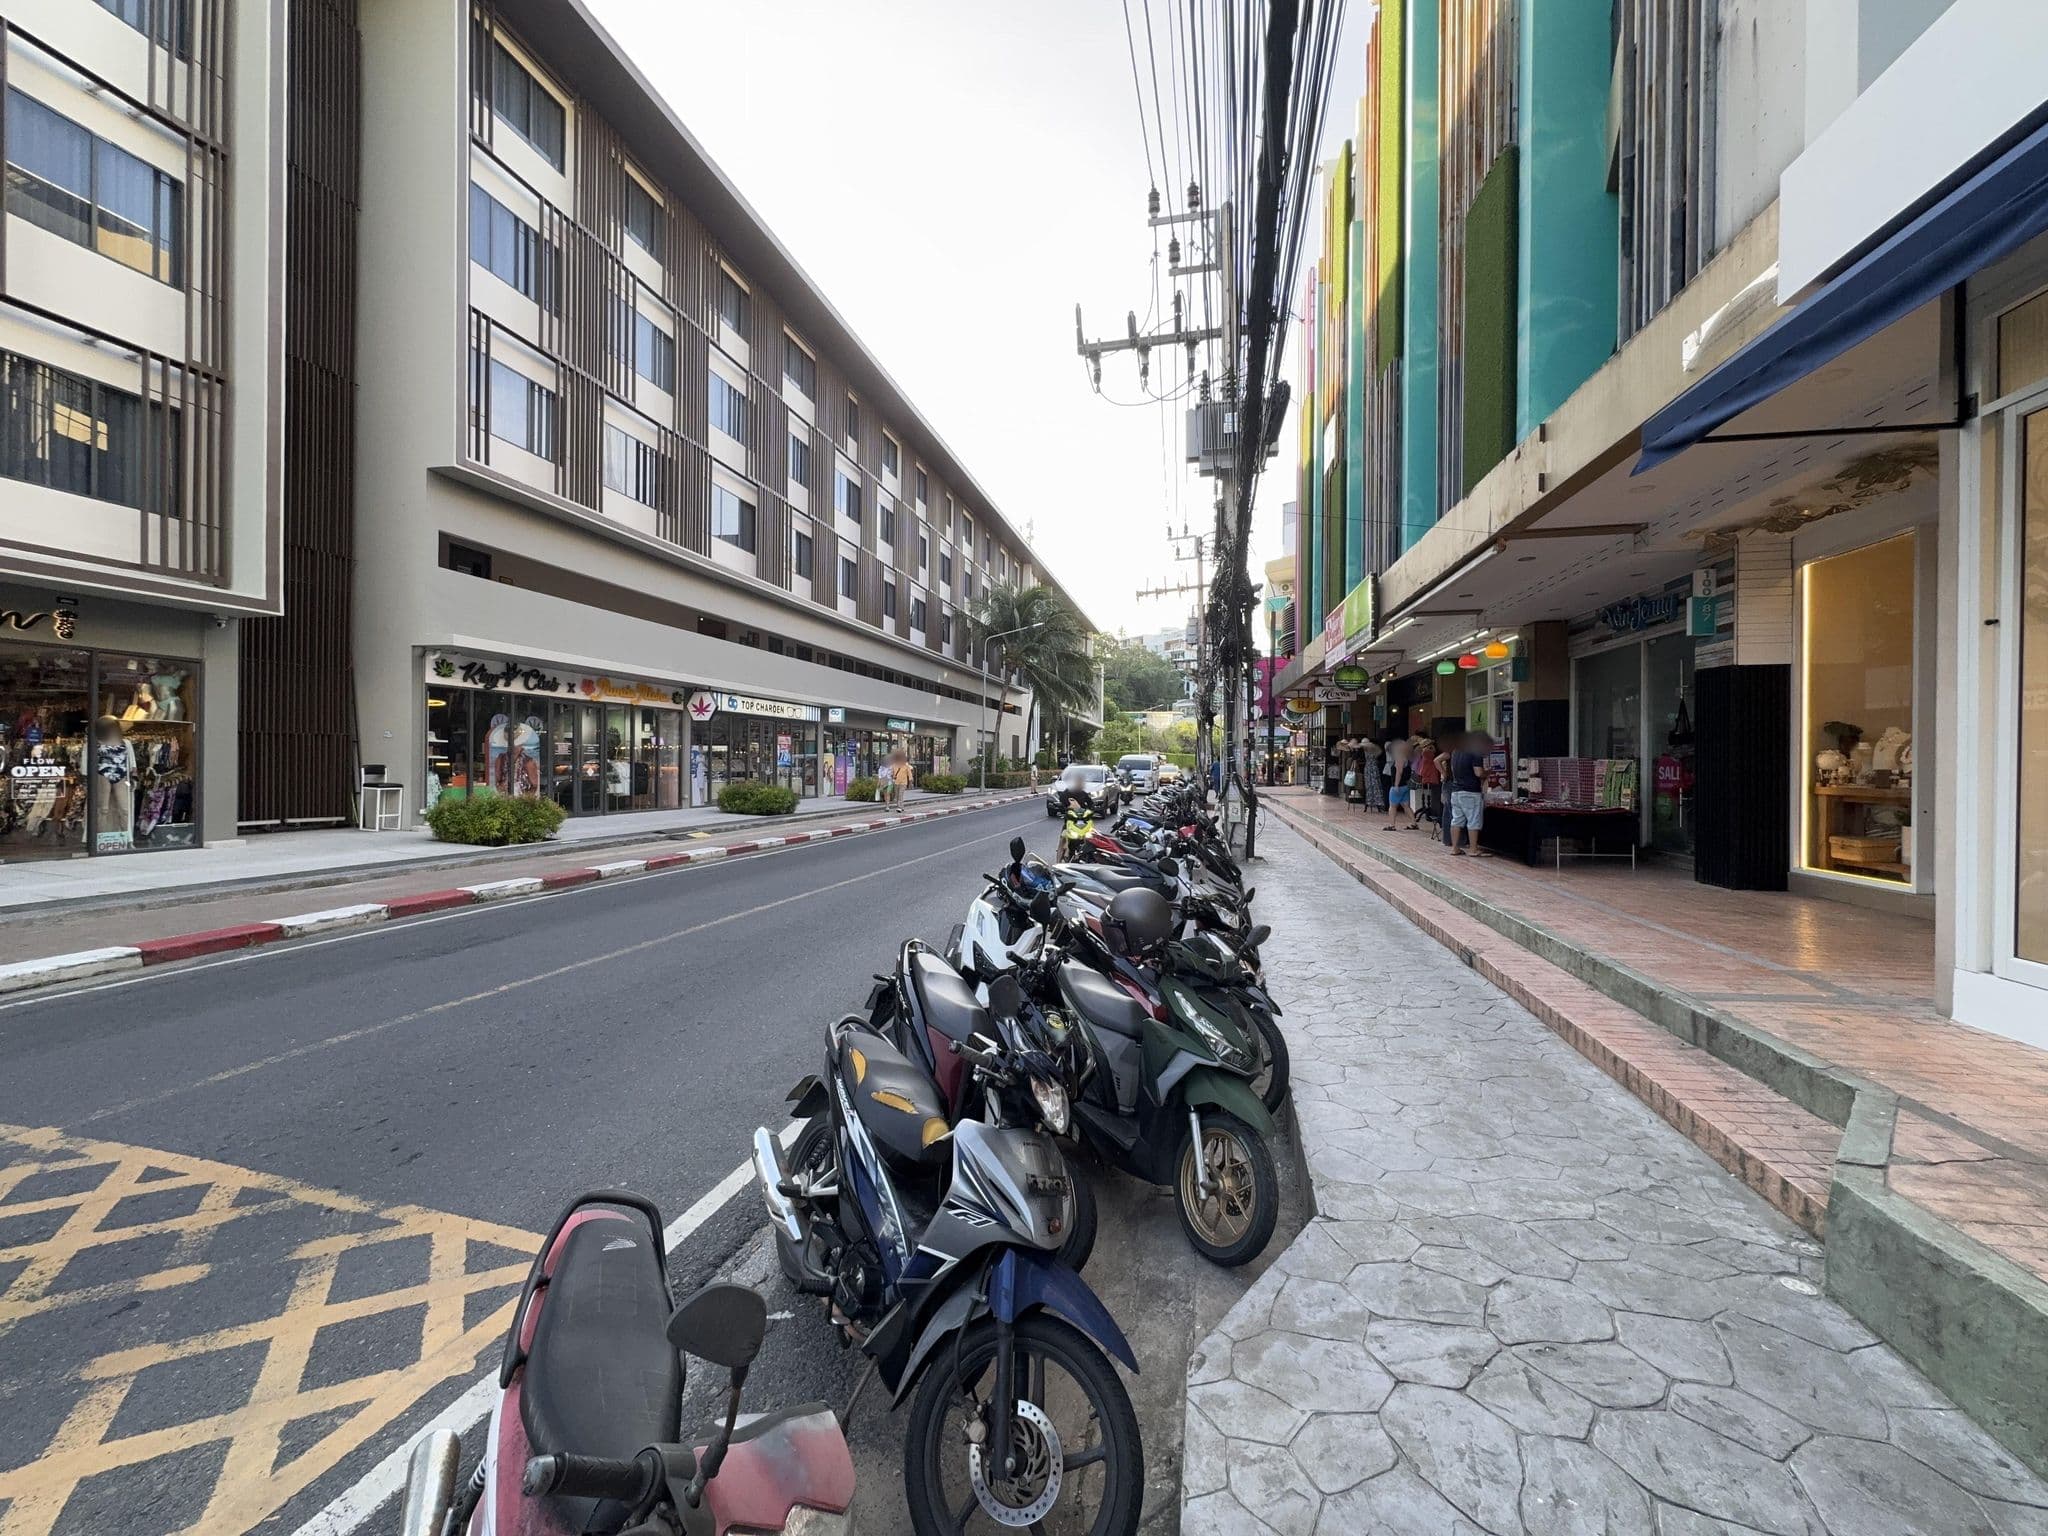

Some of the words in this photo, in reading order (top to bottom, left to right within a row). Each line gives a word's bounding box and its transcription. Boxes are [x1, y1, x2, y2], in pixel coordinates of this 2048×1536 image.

[741, 700, 755, 710] TOP
[755, 702, 785, 714] CHARDEN
[11, 766, 66, 778] OPEN
[98, 840, 126, 851] OPEN
